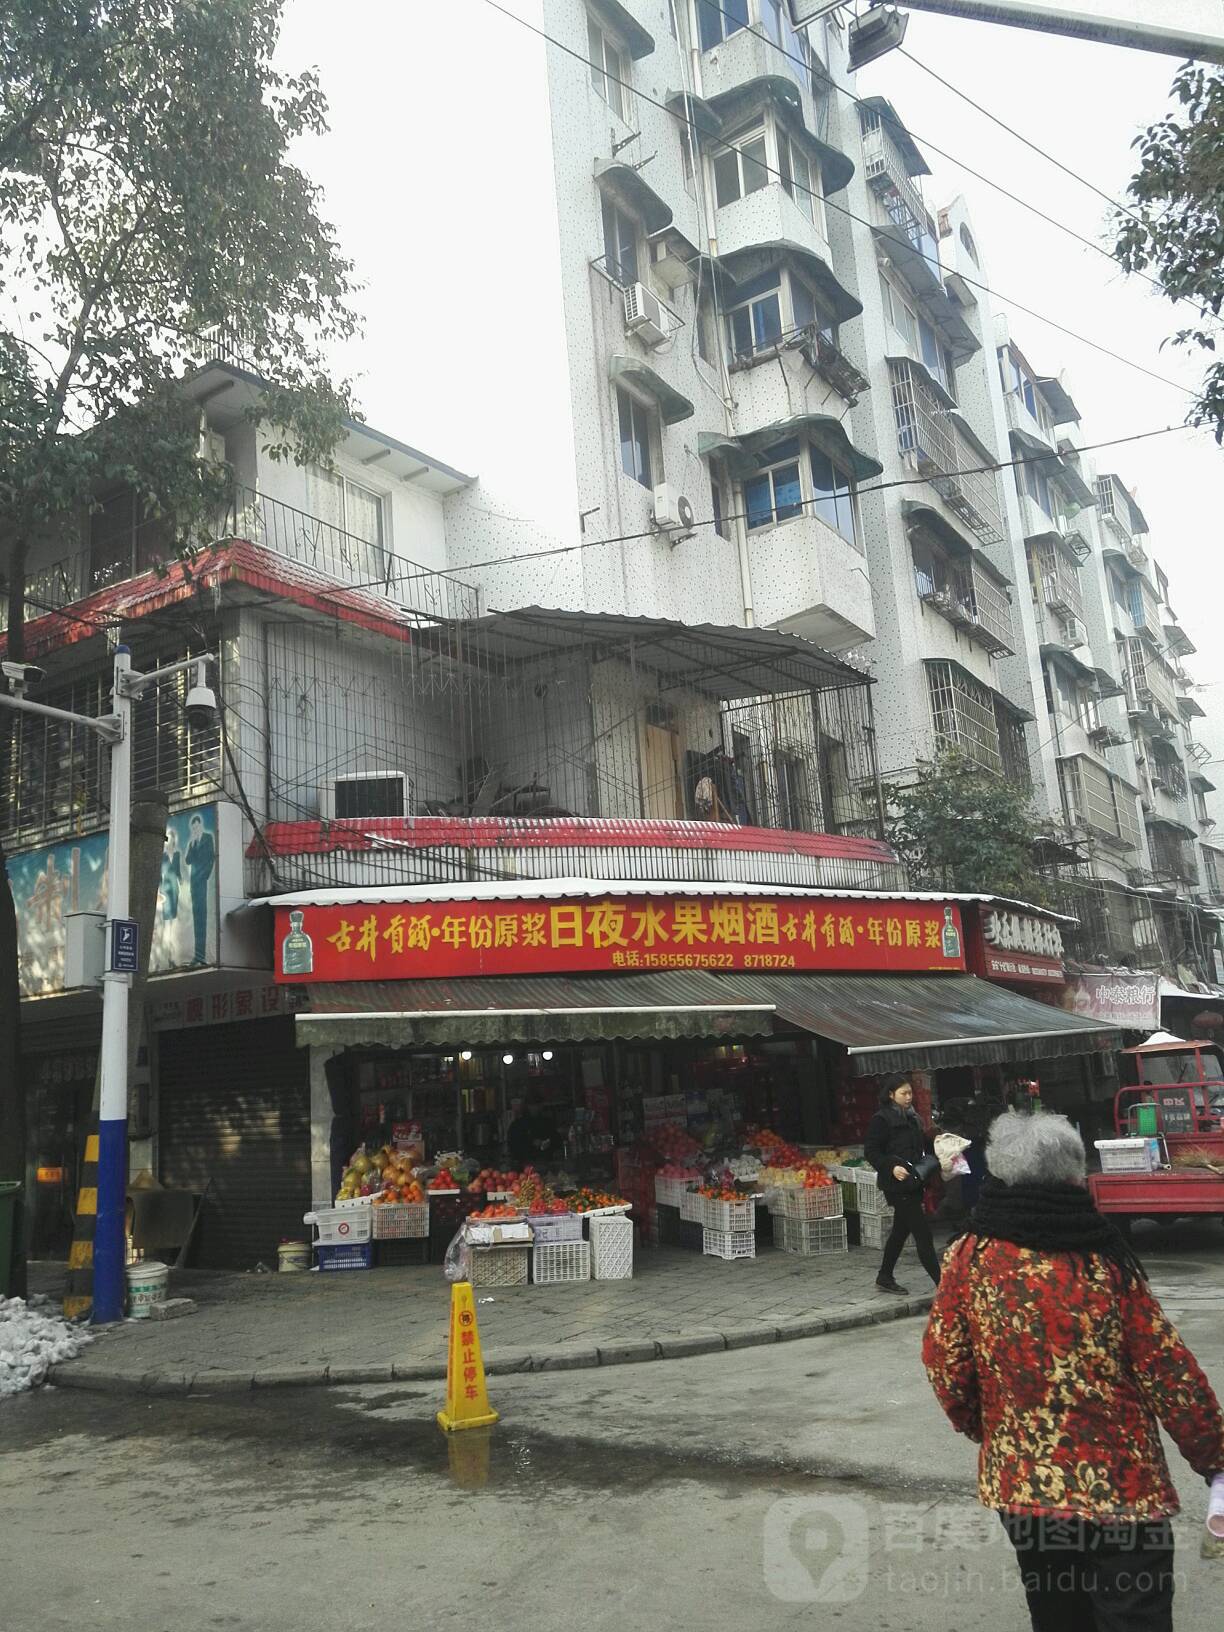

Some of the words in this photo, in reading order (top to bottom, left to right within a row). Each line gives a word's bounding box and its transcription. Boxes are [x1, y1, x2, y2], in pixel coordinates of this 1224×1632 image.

[550, 900, 780, 948] 日夜水果烟酒
[743, 953, 796, 968] 8718724
[460, 1331, 479, 1401] 禁止停车
